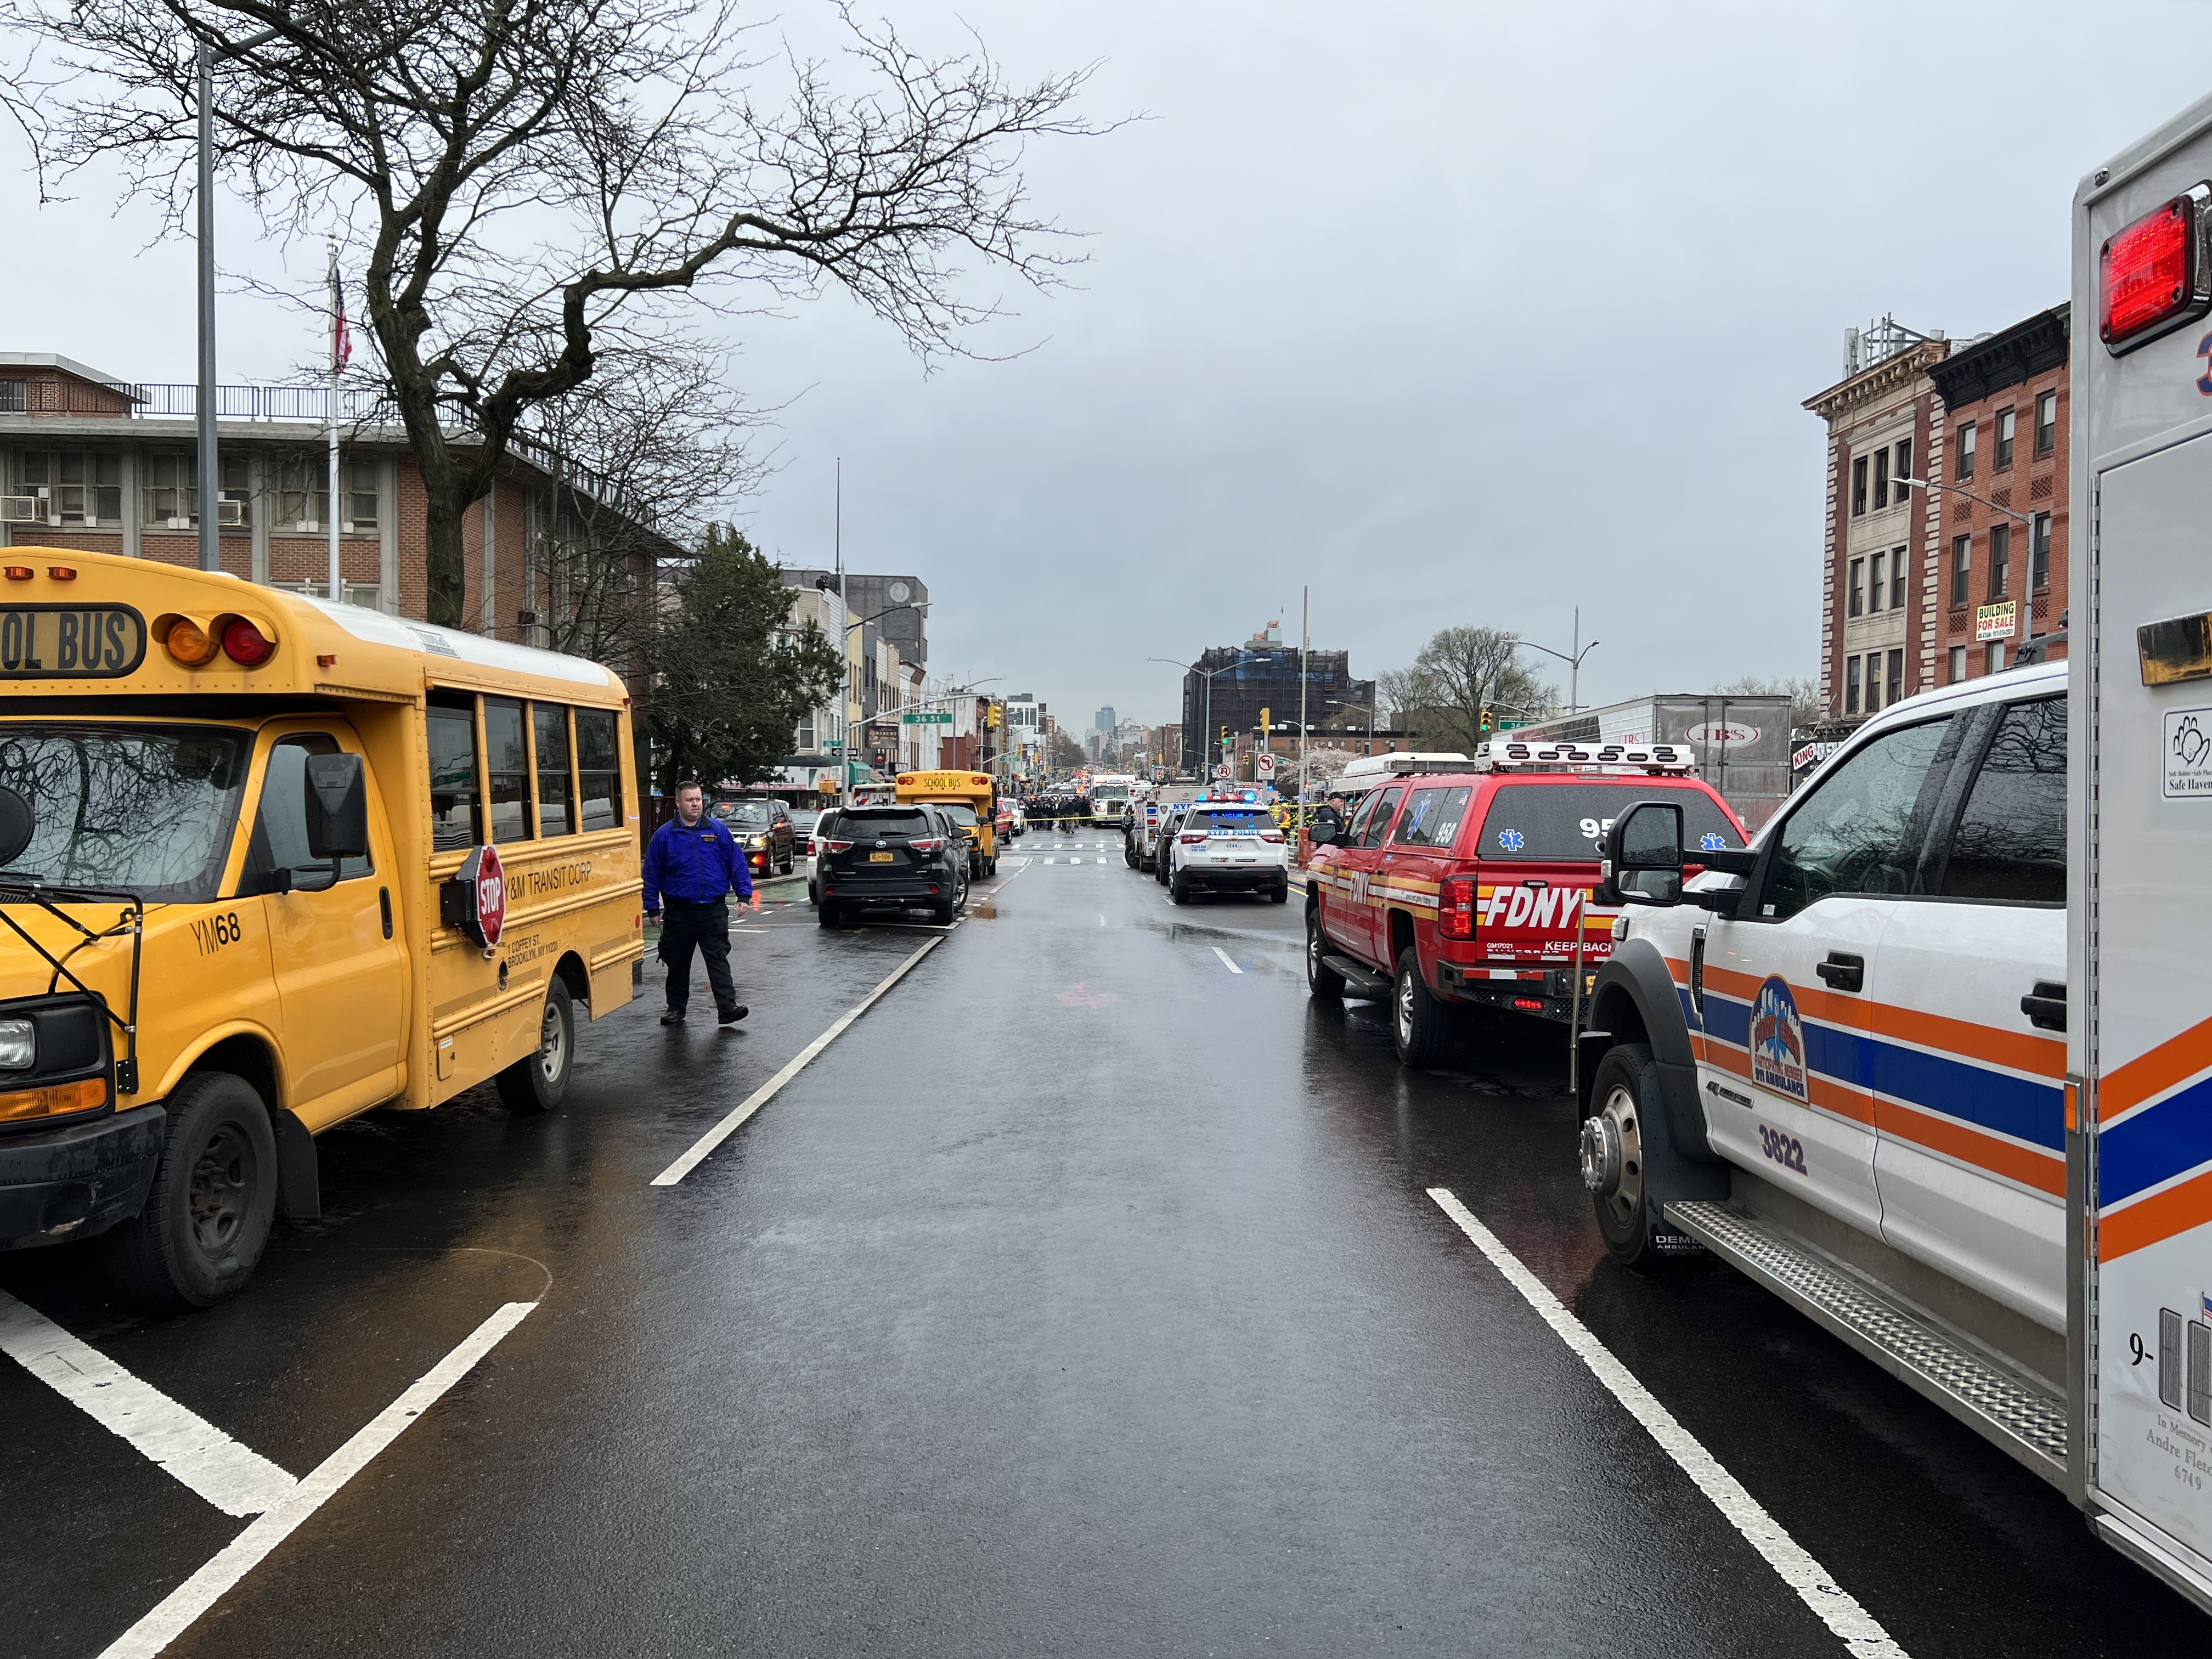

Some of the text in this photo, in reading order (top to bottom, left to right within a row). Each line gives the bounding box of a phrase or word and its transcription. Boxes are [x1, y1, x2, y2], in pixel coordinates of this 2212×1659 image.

[1978, 616, 2014, 631] FOR SALE
[1979, 602, 2014, 619] BUILDING
[58, 612, 125, 670] BUS
[1697, 729, 1745, 741] JBS
[1794, 745, 1814, 768] KING
[924, 778, 961, 787] SCHOOL BUS
[2169, 779, 2186, 790] Safe
[1435, 822, 1457, 843] 958
[480, 877, 501, 915] STOP
[504, 875, 525, 901] Y&M
[528, 866, 567, 895] TRANSIT
[1350, 871, 1370, 904] FDNY
[1484, 886, 1587, 928] FDNY
[190, 912, 241, 956] YM68
[512, 936, 532, 953] COFFEY
[1545, 941, 1578, 952] KEEP
[508, 940, 558, 968] BROOKLYN, NY 11231
[1755, 1053, 1803, 1082] PARTICIPATING MEMBER
[1756, 1066, 1805, 1098] 911 AMBULANCE
[1759, 1124, 1808, 1177] 3822
[2147, 1429, 2181, 1458] Andre
[2158, 1414, 2207, 1453] In Memory
[2174, 1465, 2202, 1491] 6749
